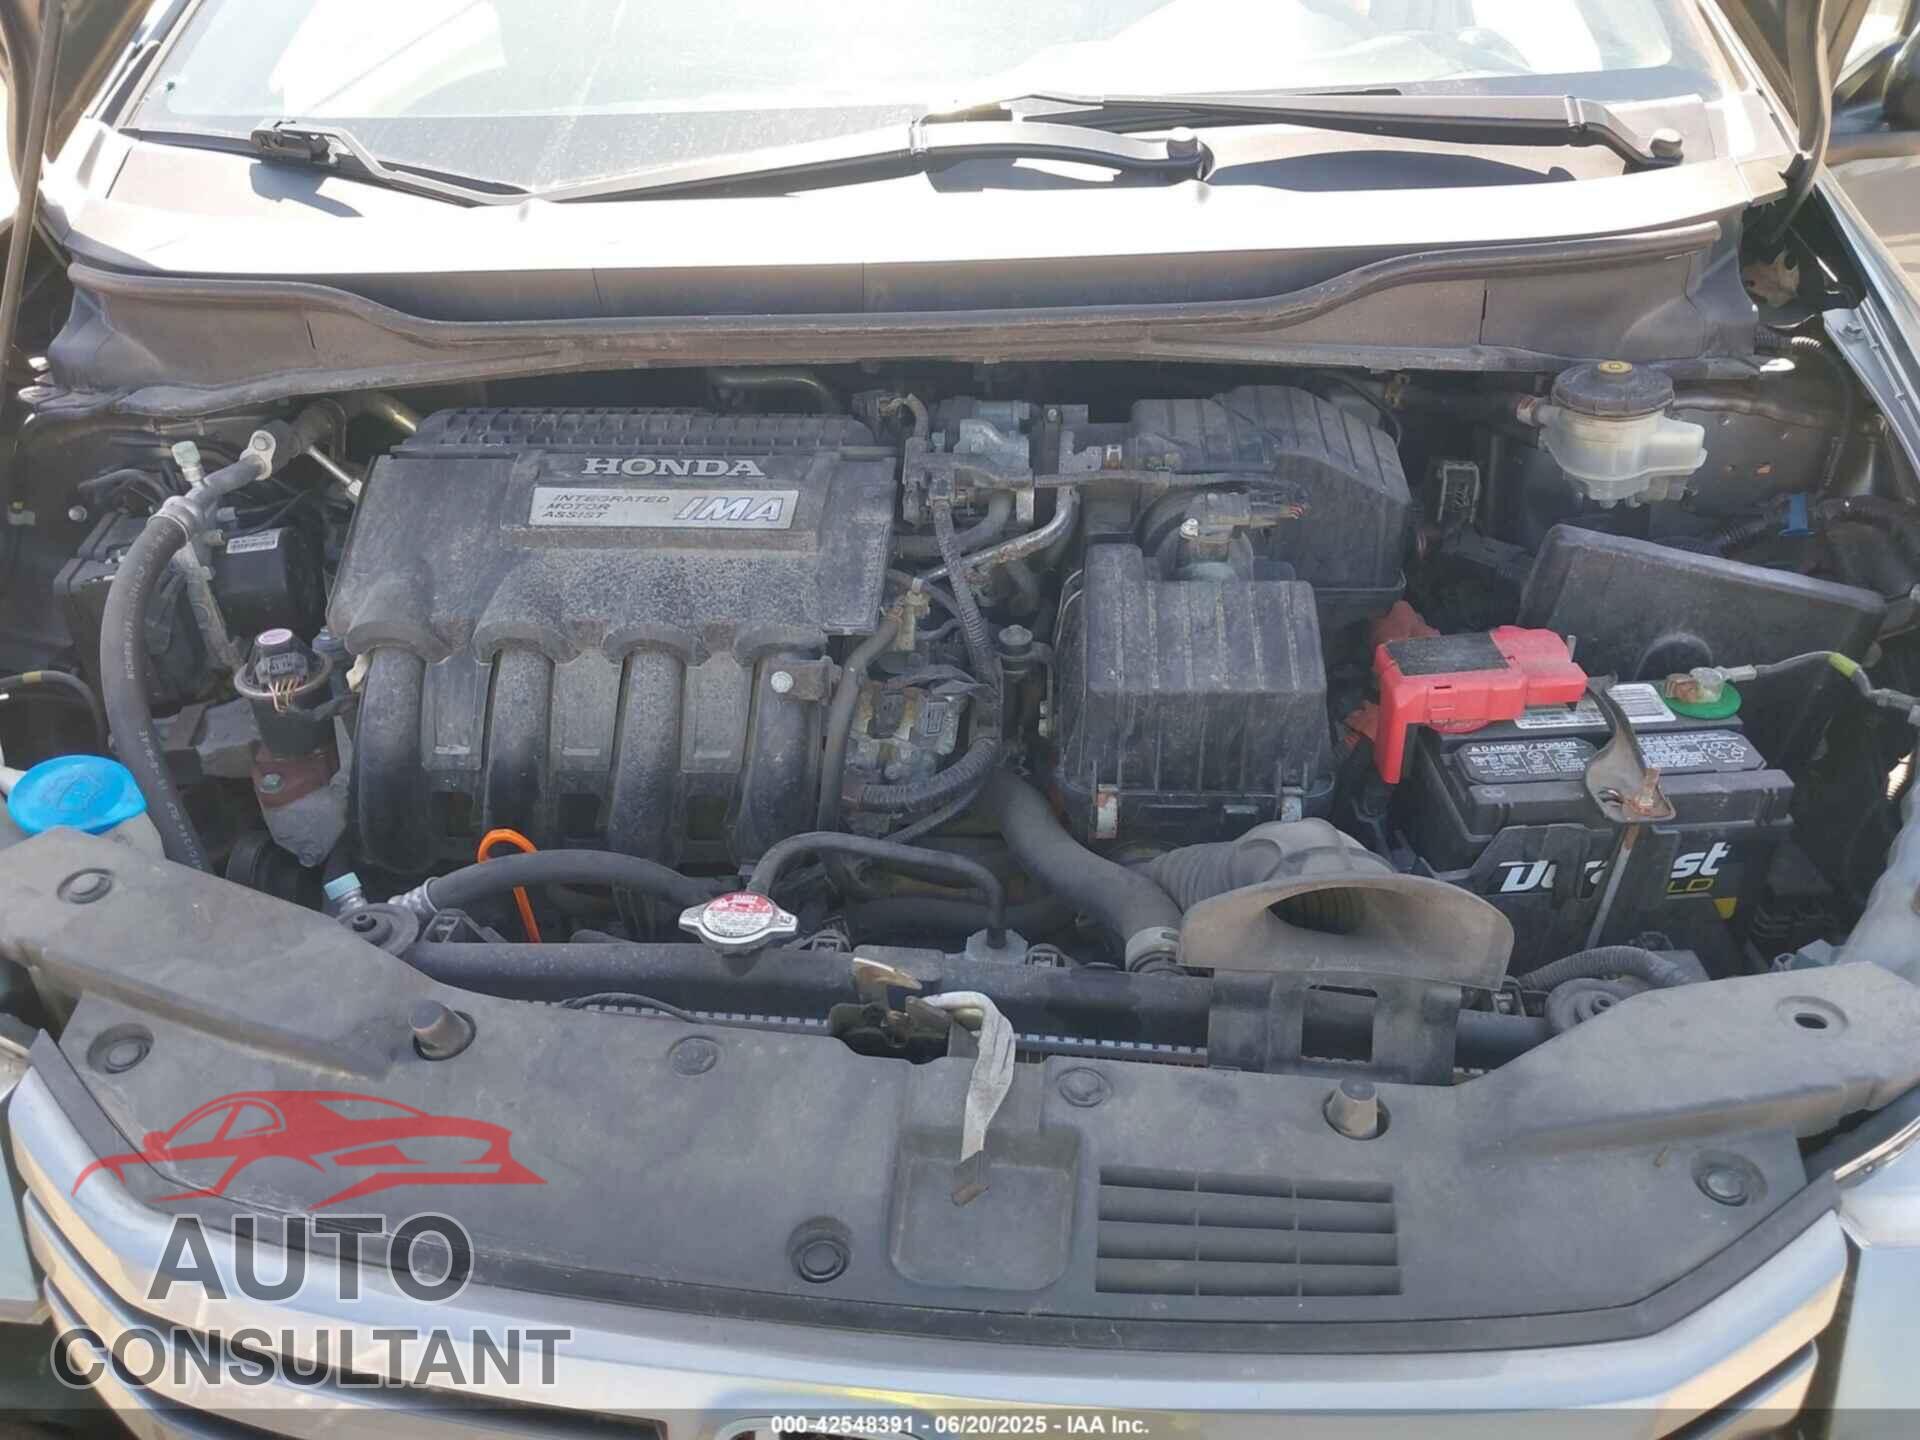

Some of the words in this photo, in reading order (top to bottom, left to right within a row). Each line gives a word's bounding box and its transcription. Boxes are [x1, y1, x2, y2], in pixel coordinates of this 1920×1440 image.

[581, 457, 766, 477] HONDA
[552, 494, 672, 504] INTEGRATED
[545, 502, 613, 511] MOTOR
[673, 495, 785, 521] IMA
[540, 510, 609, 519] ASSIST
[1480, 743, 1526, 753] DANGER
[1536, 741, 1578, 750] POISON
